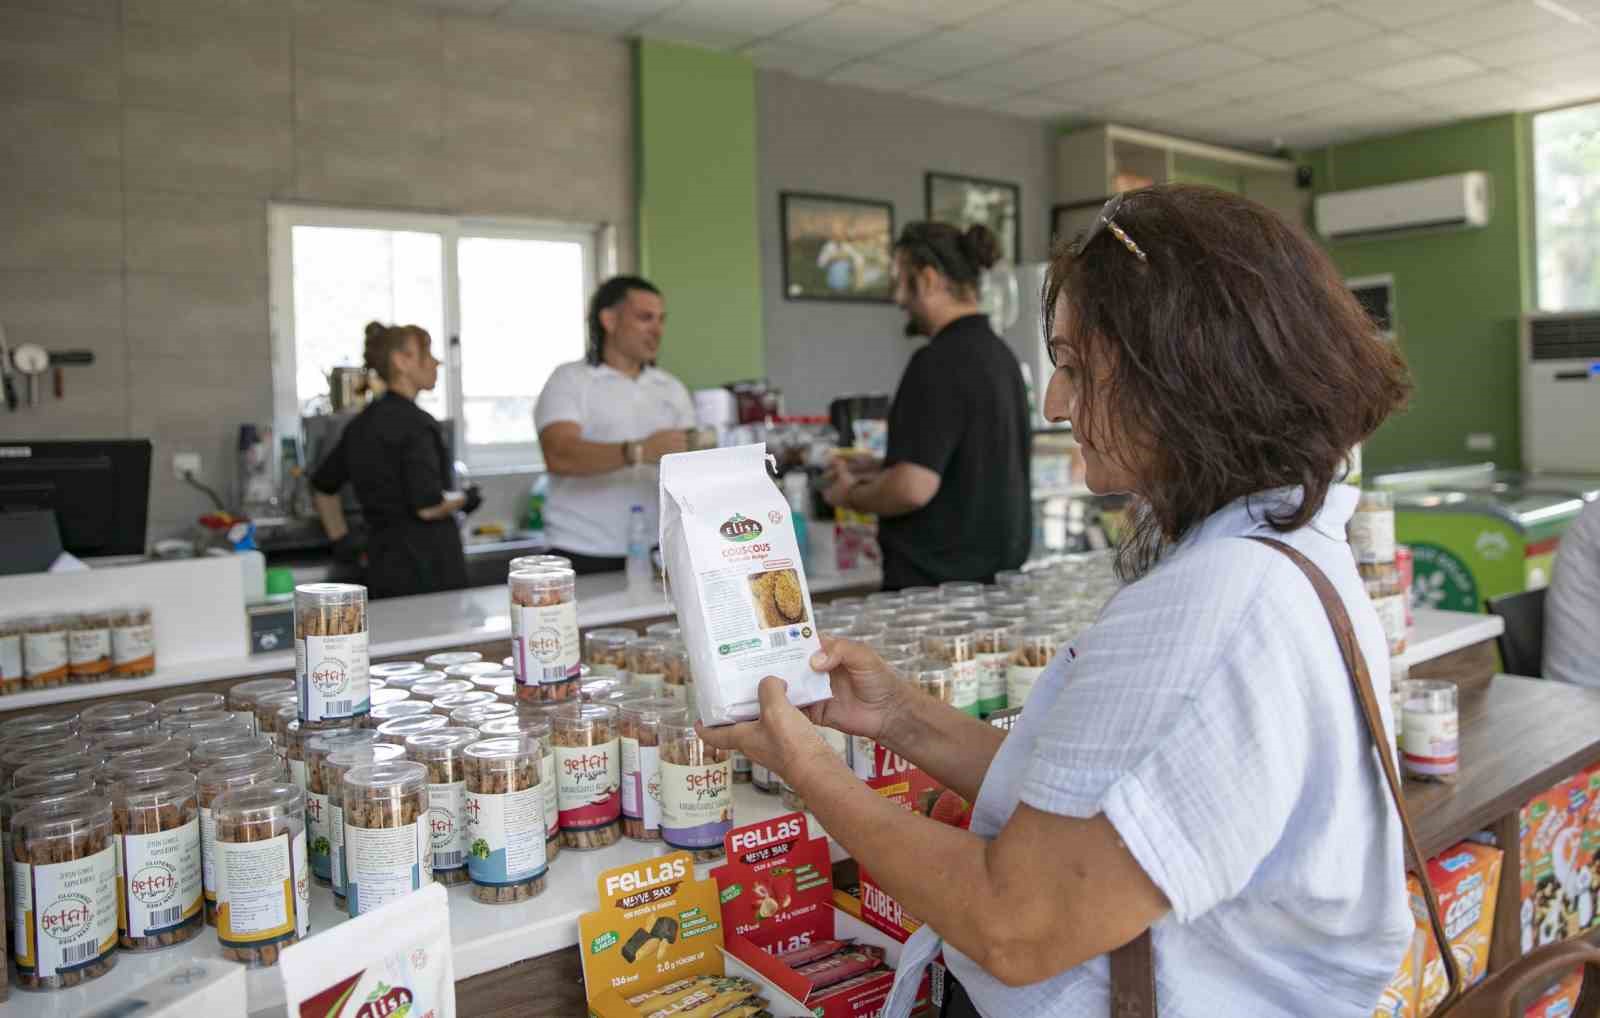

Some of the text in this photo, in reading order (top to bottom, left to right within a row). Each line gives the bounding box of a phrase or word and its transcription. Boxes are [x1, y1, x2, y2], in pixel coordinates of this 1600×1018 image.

[721, 543, 770, 558] COUSCOUS
[311, 670, 346, 688] getfit
[563, 751, 608, 775] getfit
[686, 766, 728, 791] getfit
[131, 874, 176, 894] getfit
[651, 886, 674, 898] BAR
[43, 904, 90, 930] getfit
